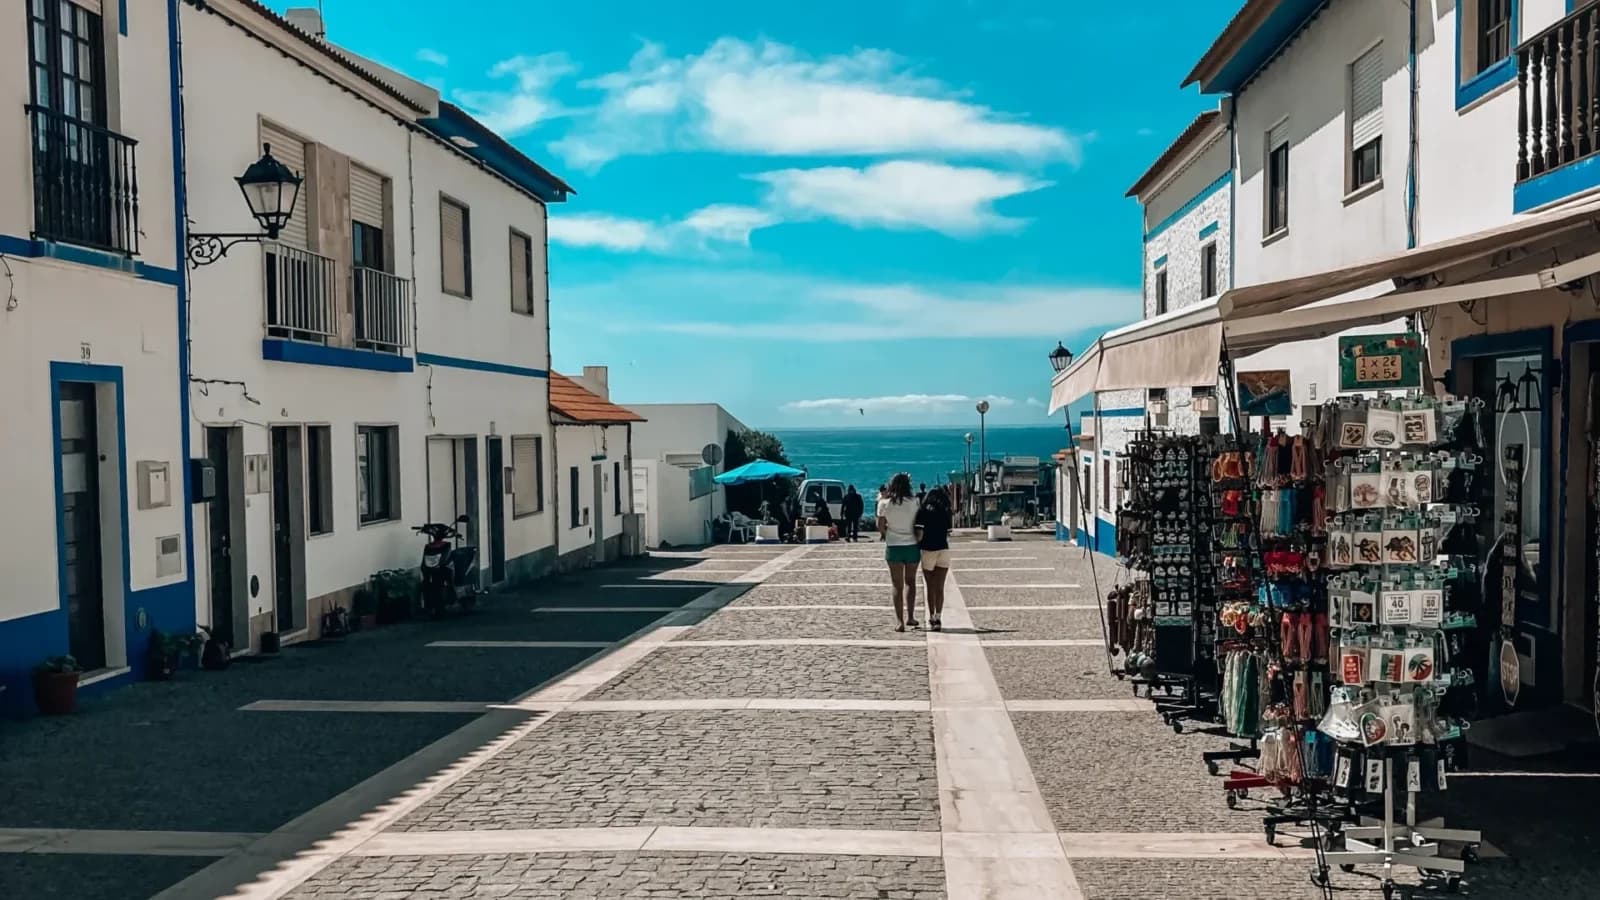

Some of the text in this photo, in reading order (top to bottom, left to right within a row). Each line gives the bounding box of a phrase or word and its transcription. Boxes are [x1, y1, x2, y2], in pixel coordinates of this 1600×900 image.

[80, 346, 91, 360] 39
[1383, 356, 1397, 367] 2€
[1360, 369, 1367, 380] 3
[1383, 368, 1398, 379] 5€
[1391, 599, 1404, 608] 40
